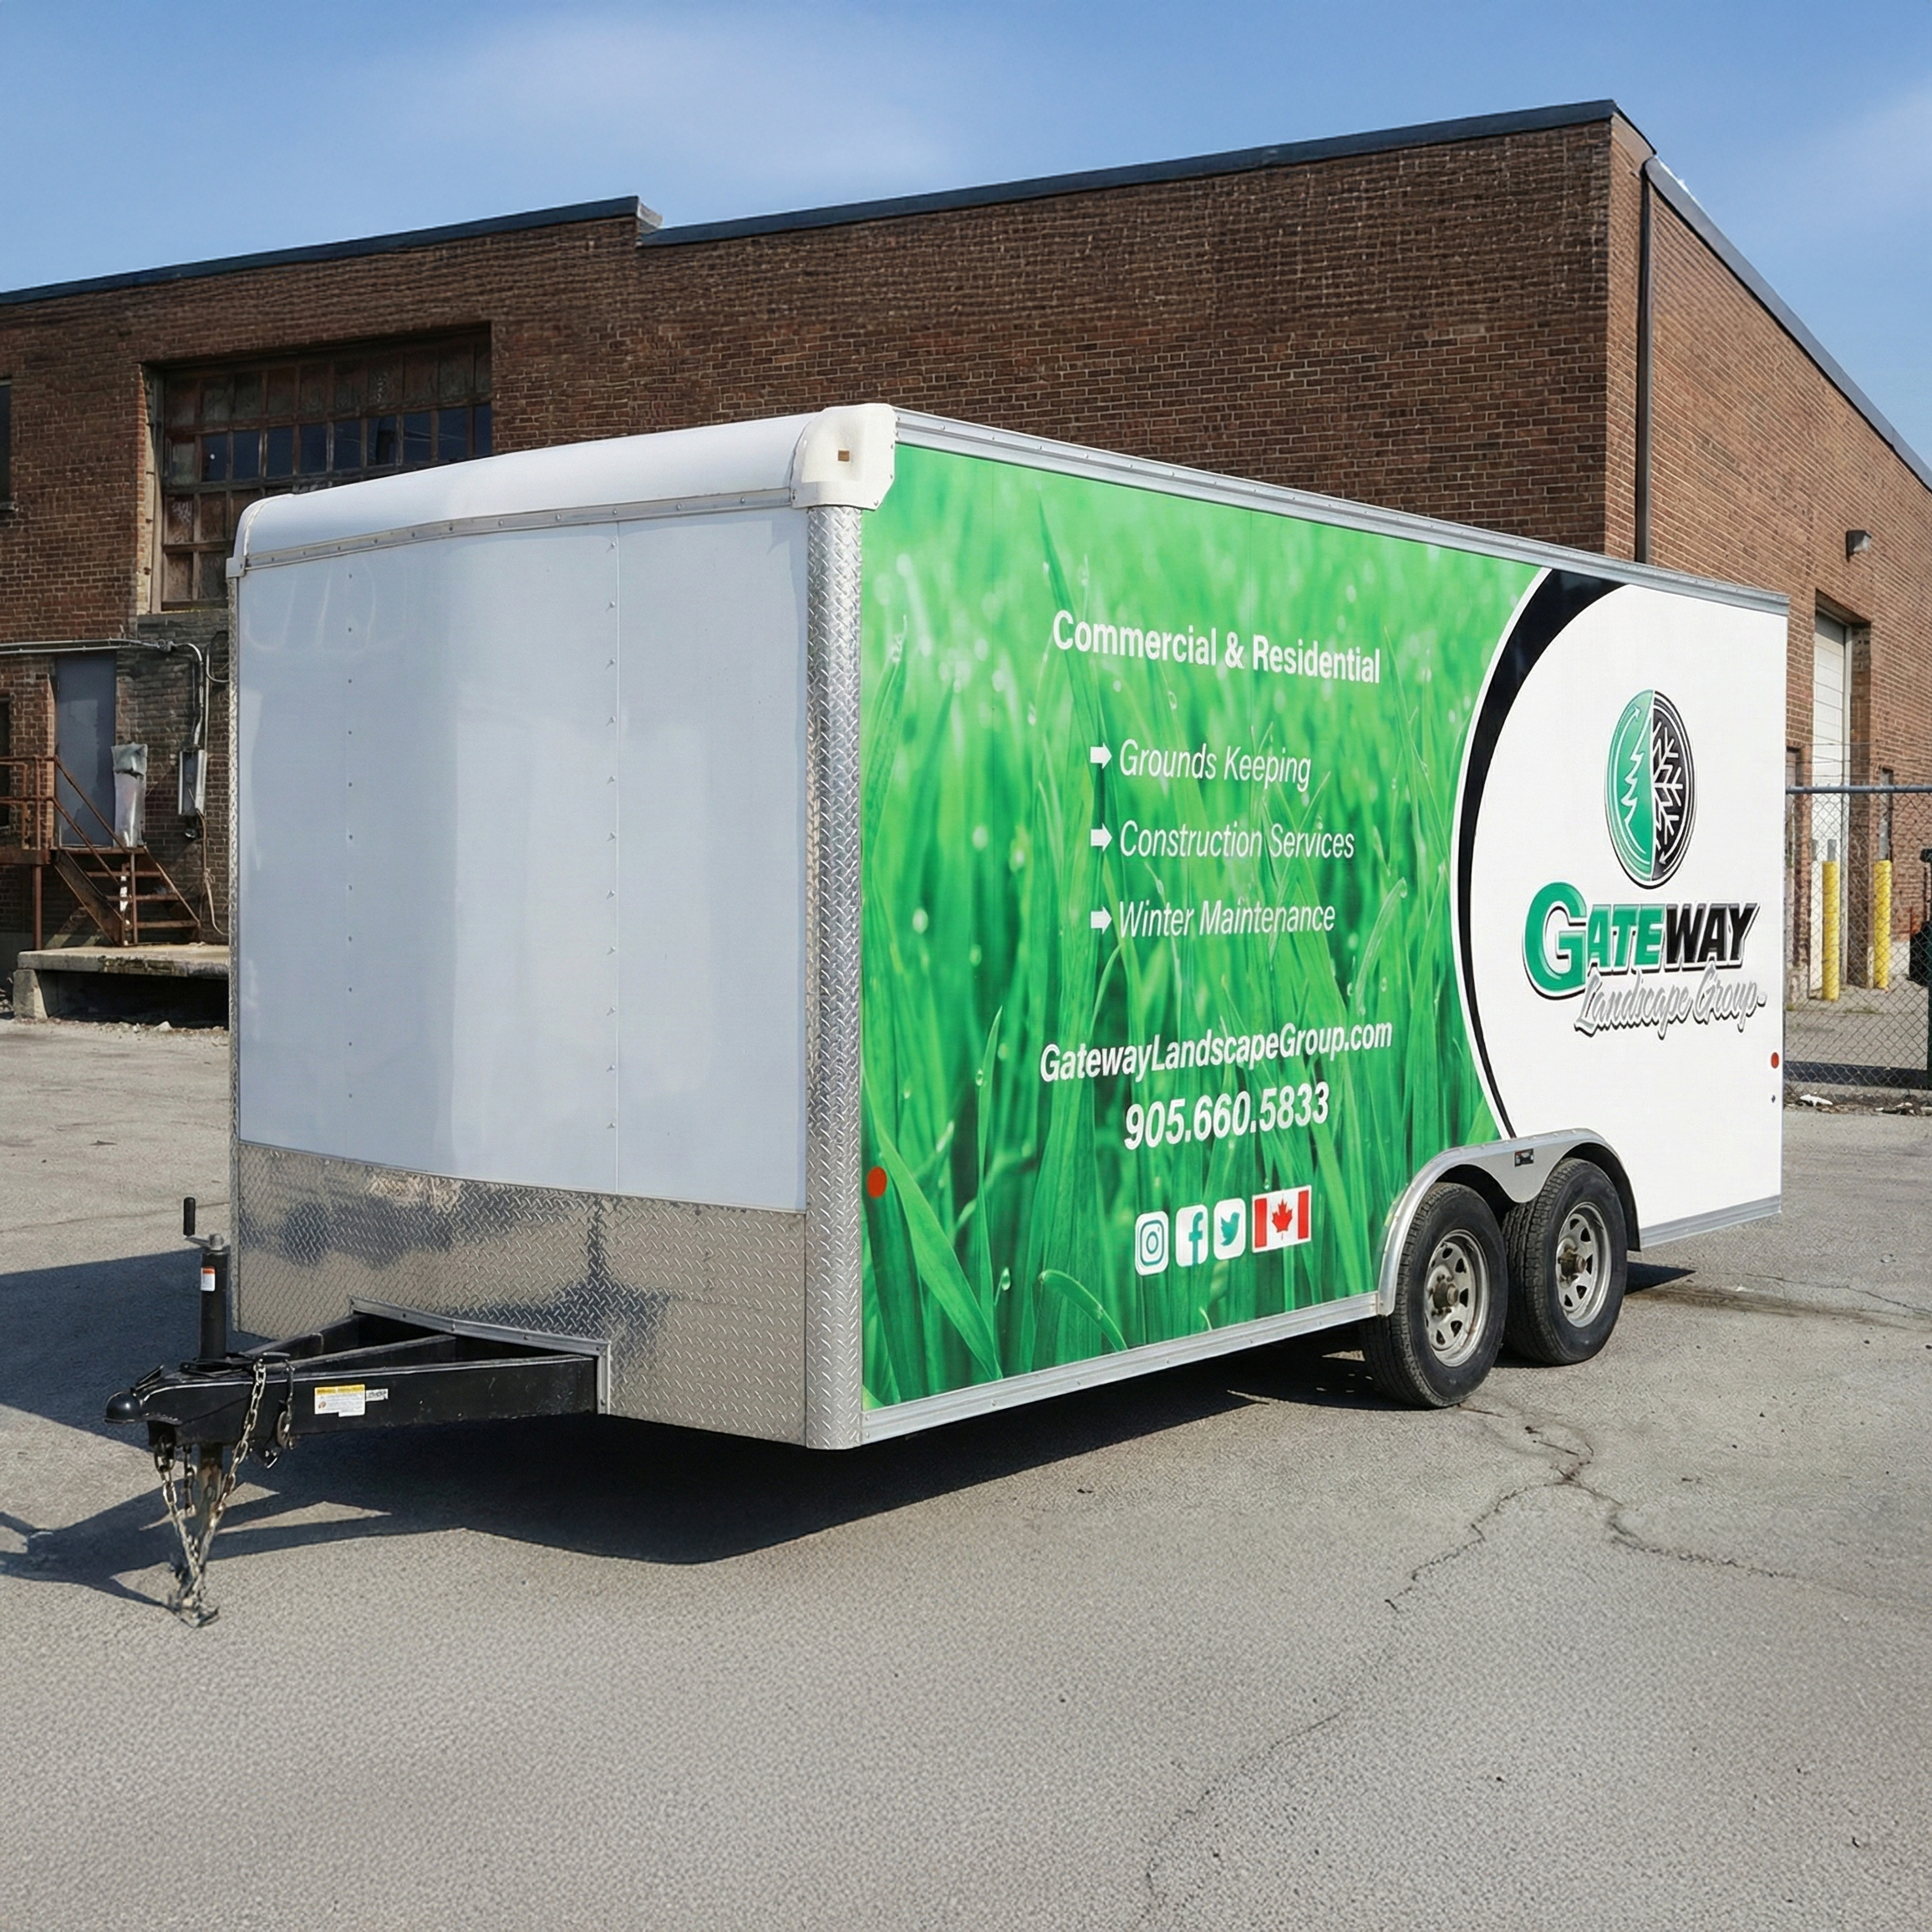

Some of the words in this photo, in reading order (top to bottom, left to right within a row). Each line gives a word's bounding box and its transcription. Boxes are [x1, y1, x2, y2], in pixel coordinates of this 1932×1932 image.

[1053, 610, 1217, 665] Commercial
[1225, 631, 1244, 669] &
[1253, 634, 1380, 684] Residential
[1120, 739, 1217, 780] Grounds
[1224, 746, 1311, 792] Keeping
[1120, 820, 1263, 857] Construction
[1269, 823, 1355, 858] Services
[1119, 899, 1194, 938] Winter
[1199, 900, 1335, 935] Maintenance
[1523, 882, 1760, 999] GATEWAY
[1574, 968, 1693, 1040] Landscape
[1040, 1022, 1392, 1082] GatewayLandscapeGroup.com
[1124, 1081, 1330, 1150] 905.660.5833
